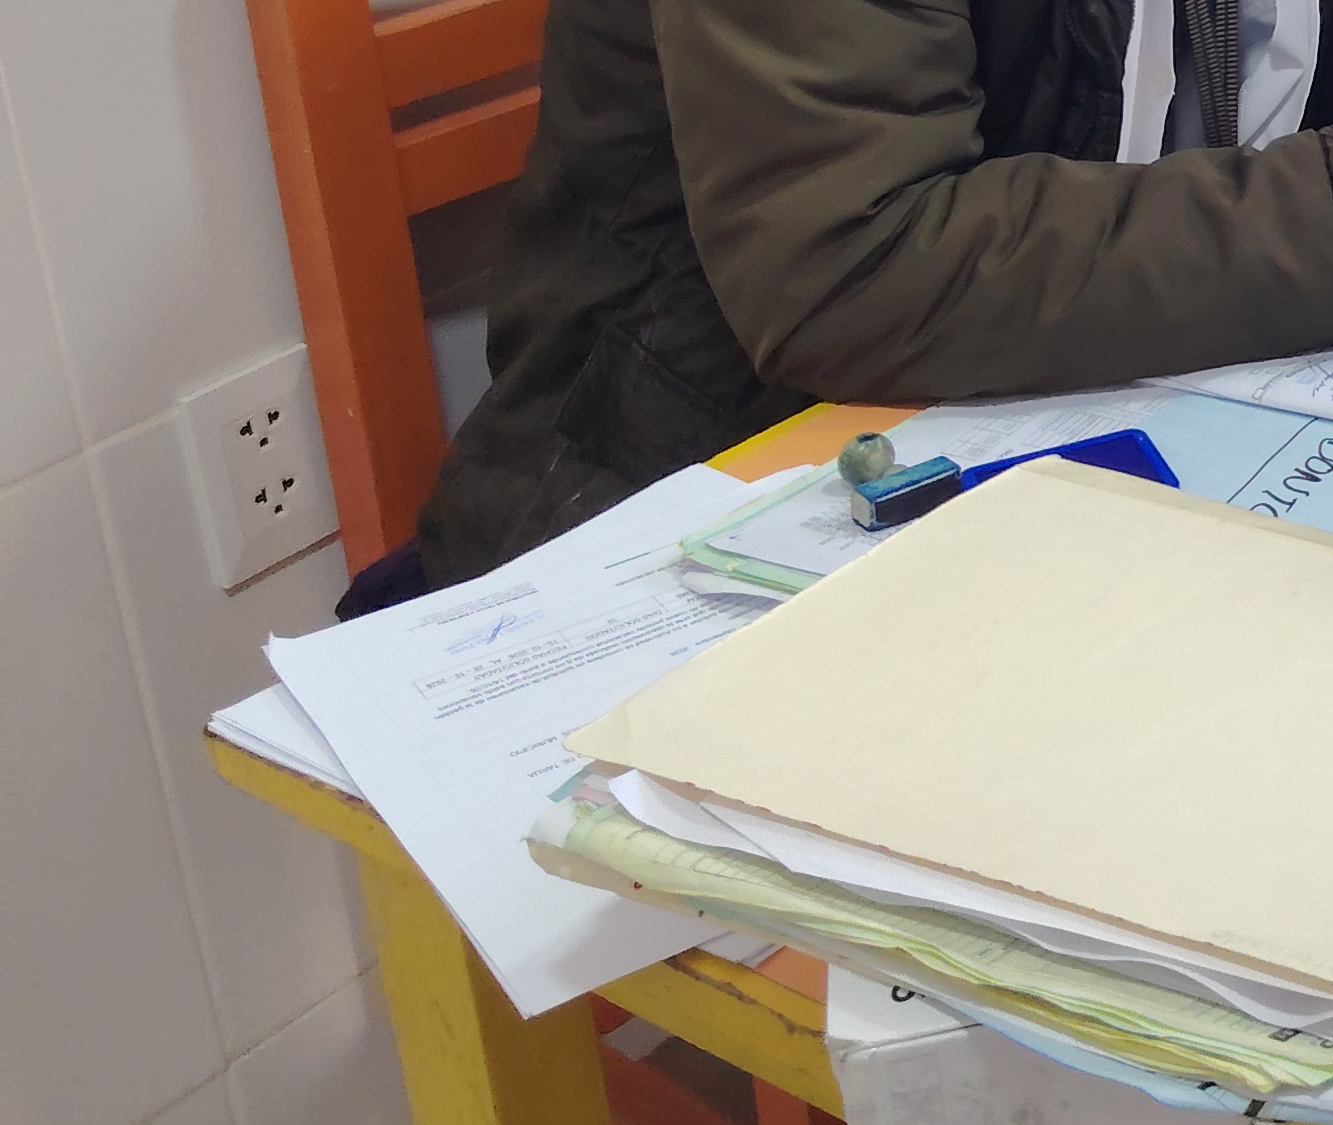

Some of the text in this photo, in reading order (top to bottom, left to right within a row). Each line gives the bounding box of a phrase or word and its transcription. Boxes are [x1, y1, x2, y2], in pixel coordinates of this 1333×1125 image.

[472, 656, 531, 681] SOLICITADAS
[509, 734, 558, 758] MUNICIPIO
[526, 761, 560, 778] TARIJA
